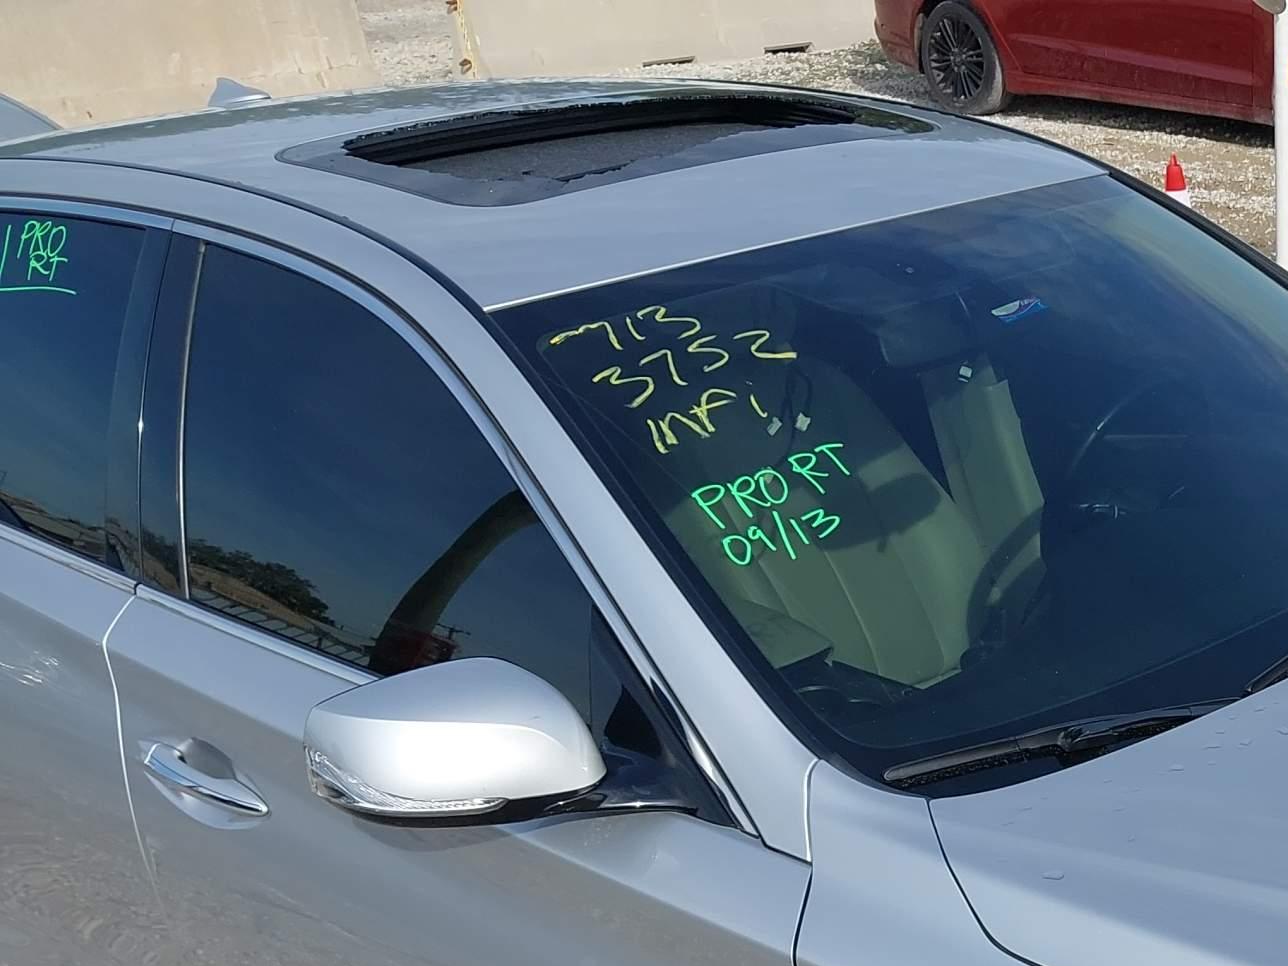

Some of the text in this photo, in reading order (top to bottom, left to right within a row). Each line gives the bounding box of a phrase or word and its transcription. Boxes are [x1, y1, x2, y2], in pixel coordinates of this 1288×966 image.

[16, 220, 68, 259] PRO
[27, 251, 69, 281] RT
[550, 305, 702, 351] 713
[591, 330, 798, 409] 3752
[691, 442, 852, 530] PRO RT
[720, 508, 841, 567] 09/13
